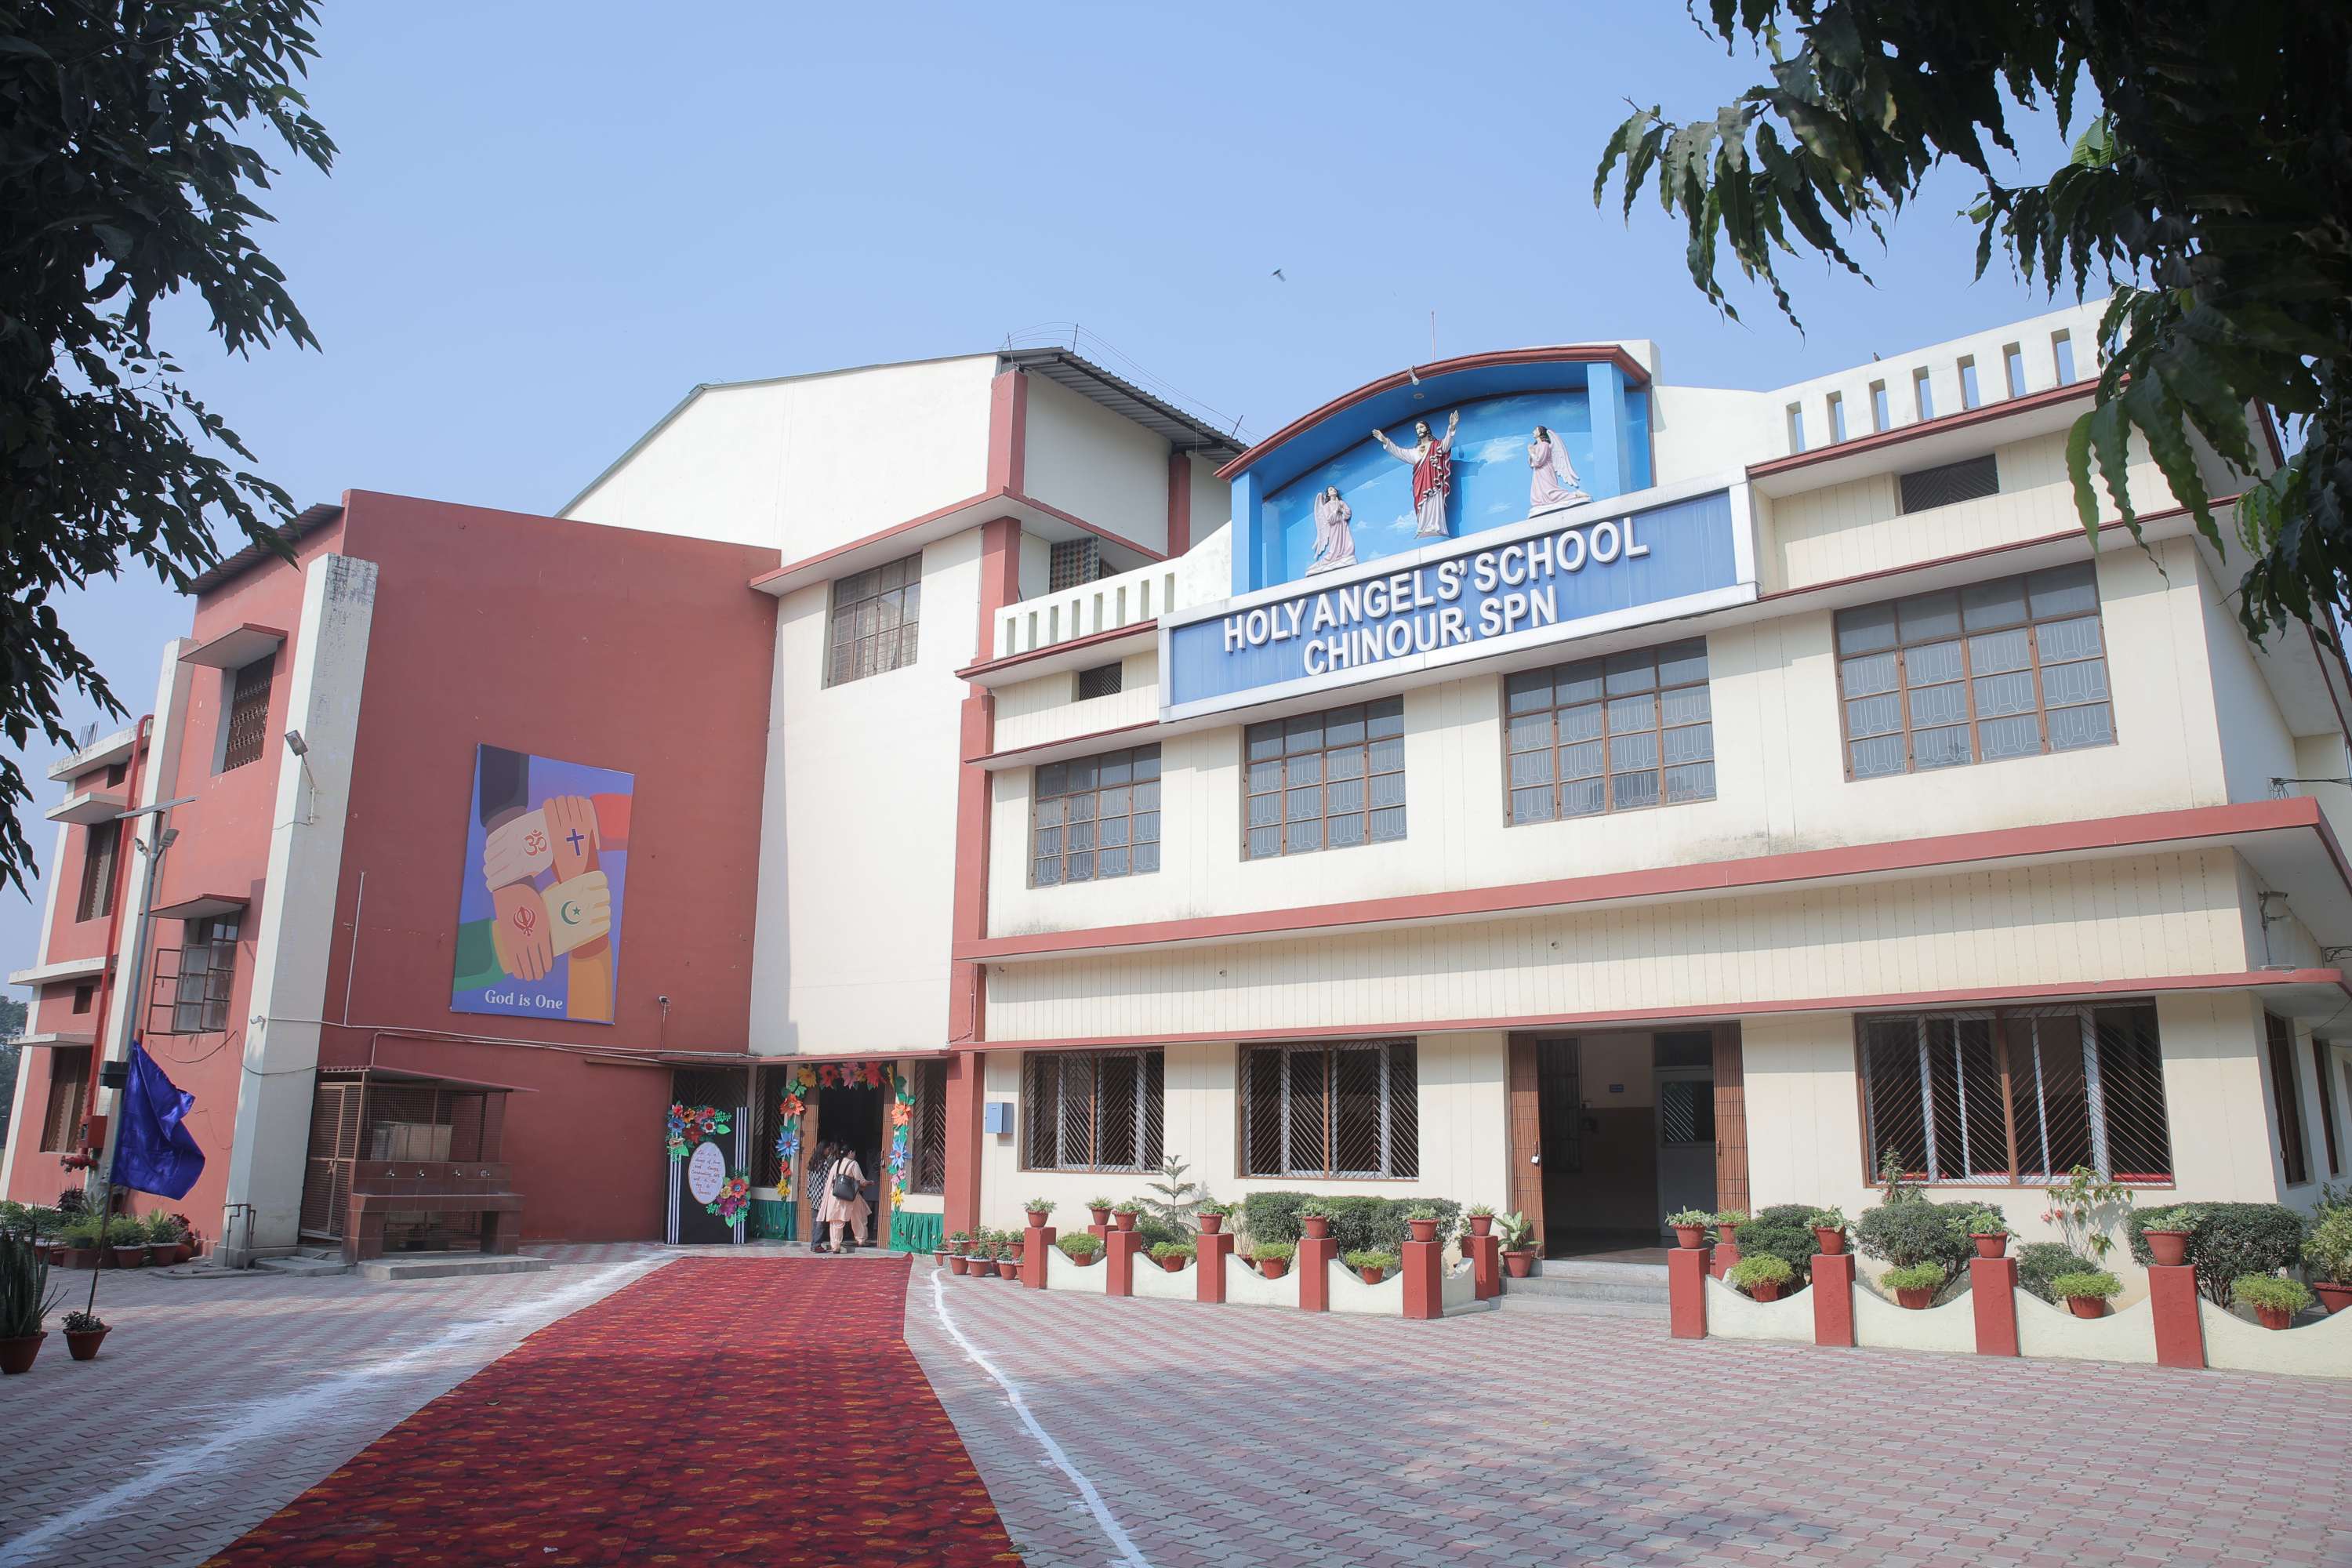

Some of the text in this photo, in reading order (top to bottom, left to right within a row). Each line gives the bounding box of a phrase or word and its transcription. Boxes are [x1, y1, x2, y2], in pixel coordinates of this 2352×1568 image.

[1224, 598, 1308, 652] HOLY
[1474, 517, 1650, 592] SCHOOL
[1304, 585, 1558, 676] CHINOUR, SPN
[485, 989, 563, 1010] God is One
